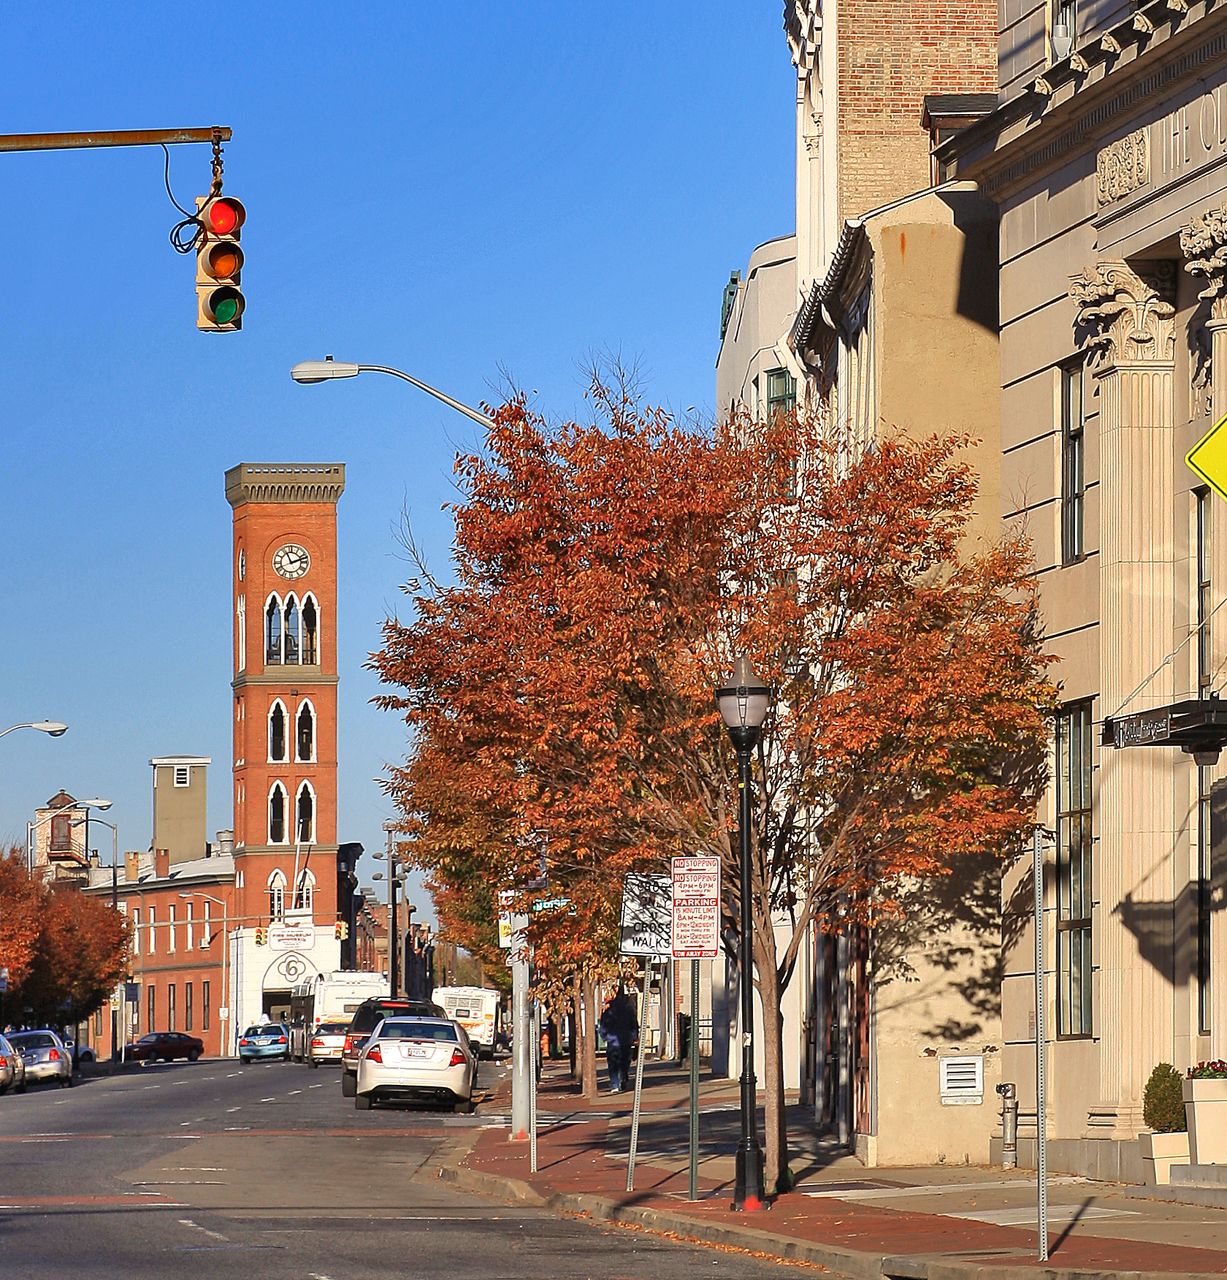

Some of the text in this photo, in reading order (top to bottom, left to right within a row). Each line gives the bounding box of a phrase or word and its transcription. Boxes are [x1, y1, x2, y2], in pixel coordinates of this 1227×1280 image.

[1161, 105, 1191, 174] THE
[674, 860, 717, 868] NO STOPPING
[674, 874, 717, 882] NO STOPPING
[285, 959, 298, 976] 6
